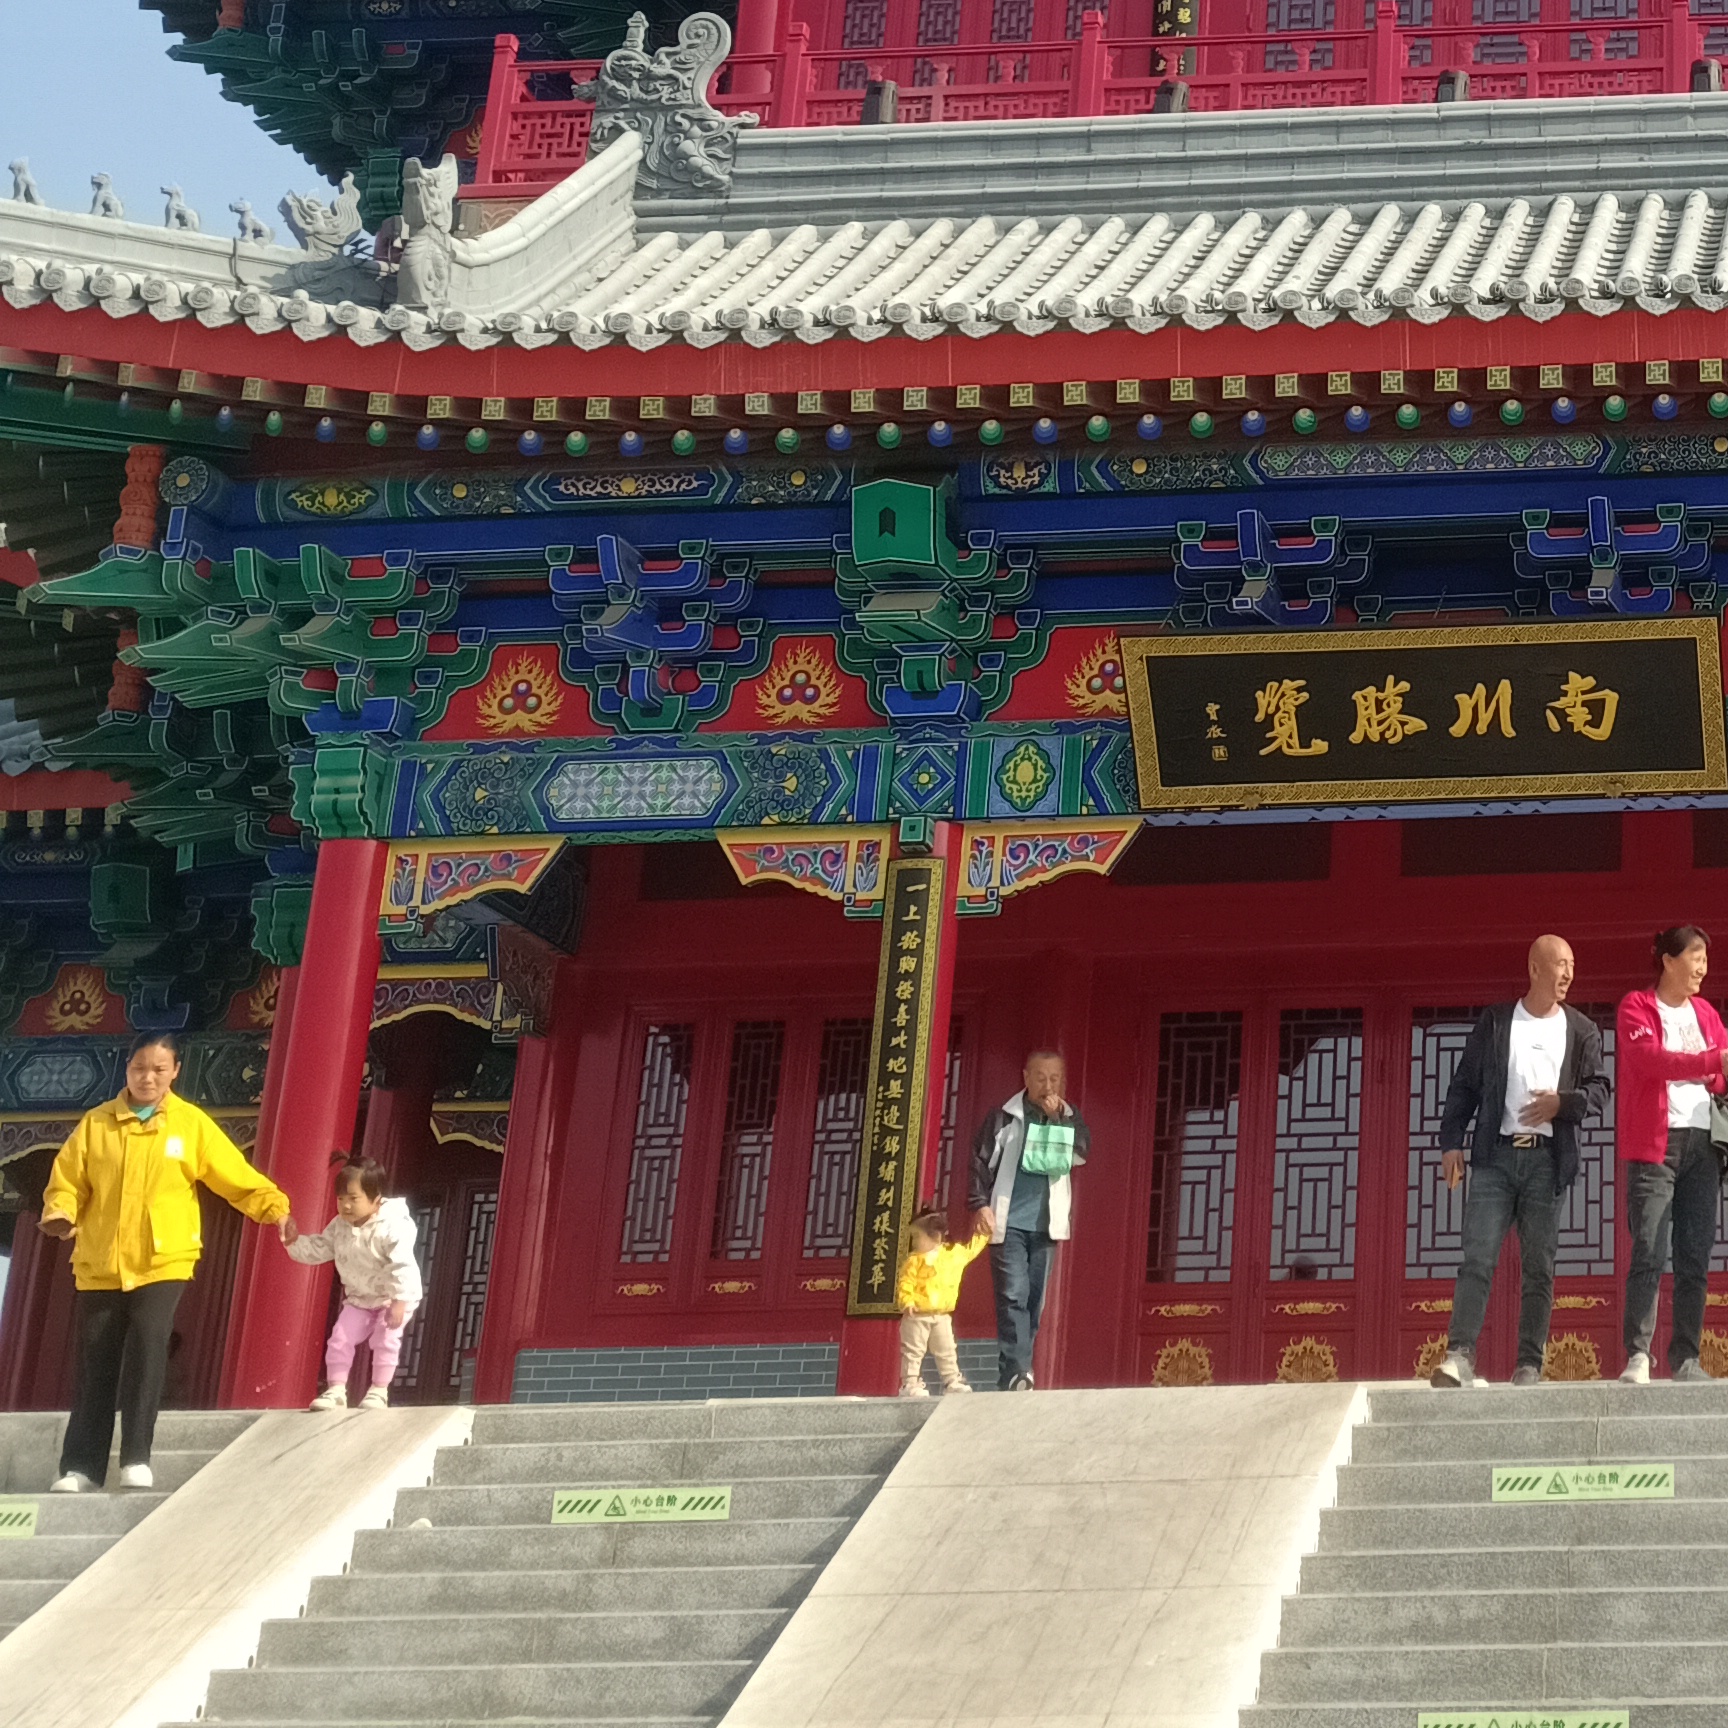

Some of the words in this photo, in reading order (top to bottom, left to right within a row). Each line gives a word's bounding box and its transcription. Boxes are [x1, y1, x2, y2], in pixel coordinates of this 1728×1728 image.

[1572, 1471, 1620, 1485] 小心台阶
[630, 1494, 678, 1507] 小心台阶
